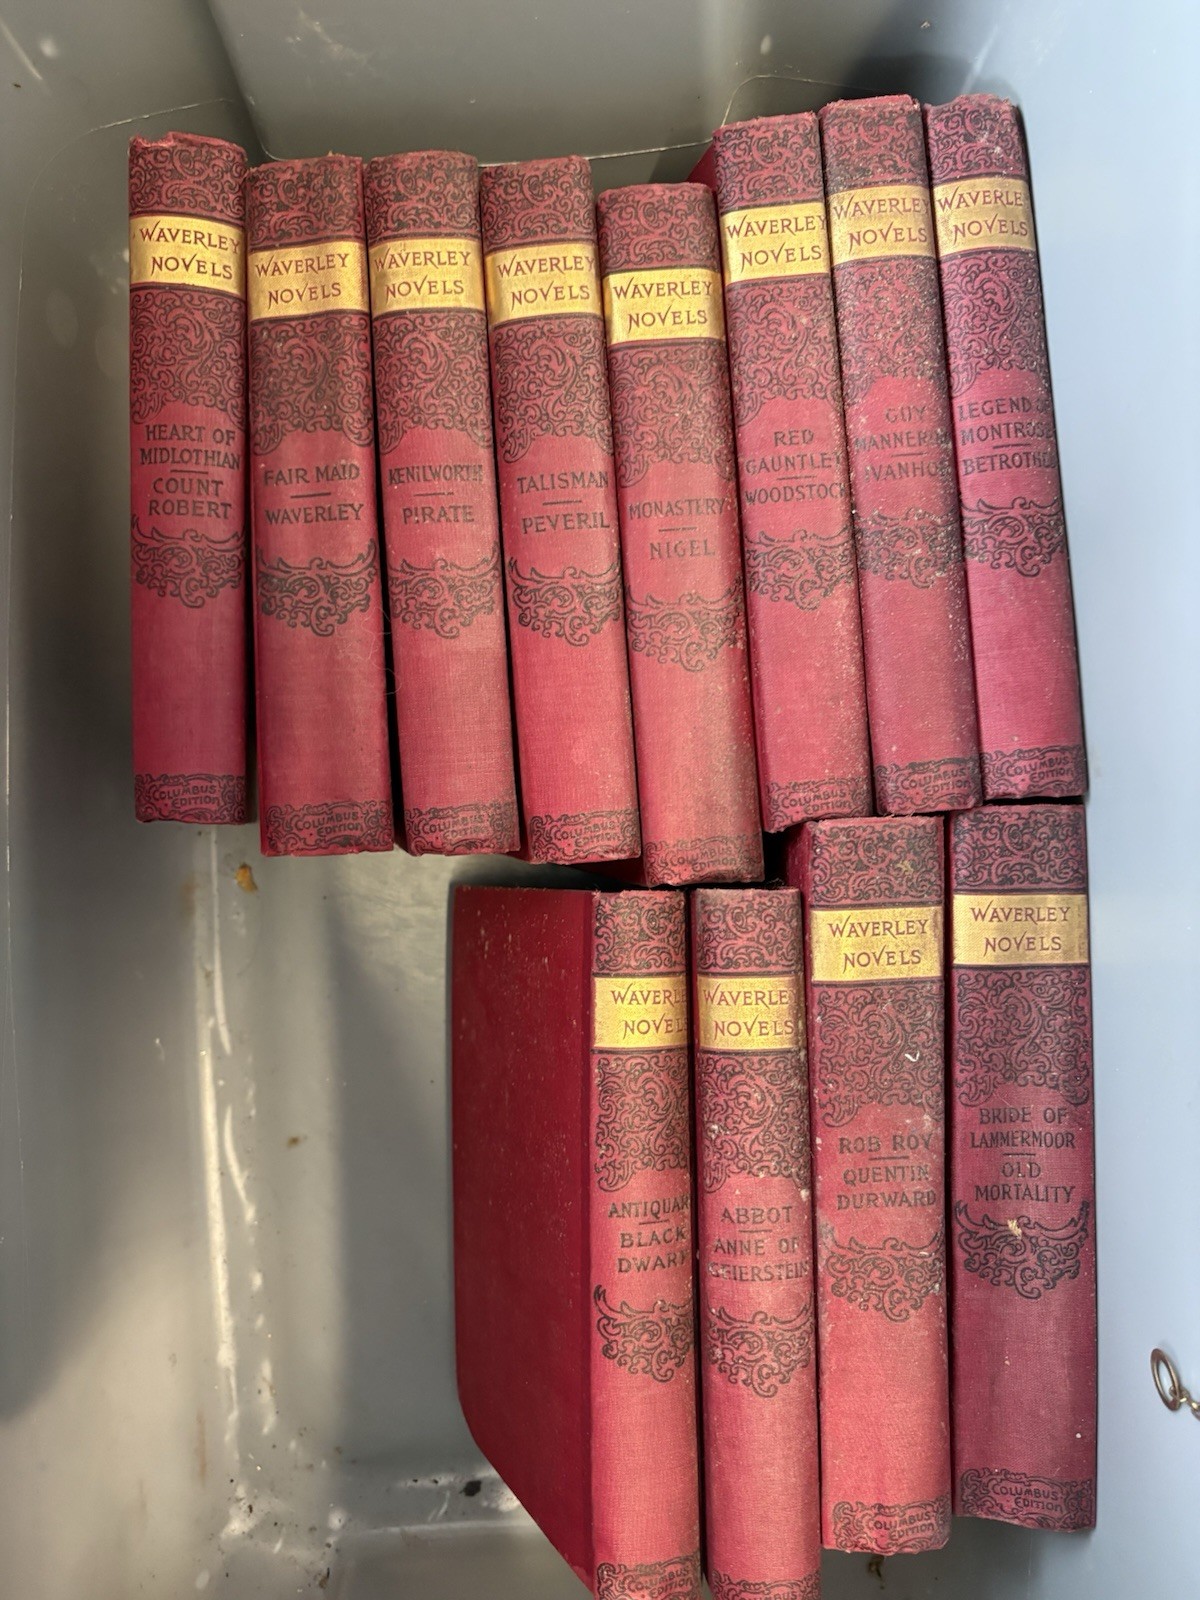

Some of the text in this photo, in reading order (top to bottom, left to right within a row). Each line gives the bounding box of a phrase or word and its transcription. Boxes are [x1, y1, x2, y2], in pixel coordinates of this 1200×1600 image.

[833, 195, 930, 220] WAVERLEY
[139, 221, 241, 253] WAVERLEY
[726, 215, 827, 239] WAVERLEY
[849, 221, 928, 253] NOVELS
[953, 213, 1028, 245] NOVELS
[151, 254, 233, 280] NOVELS
[256, 253, 350, 279] WAVERLEY
[375, 249, 471, 272] WAVERLEY
[497, 254, 595, 278] WAVERLEY
[740, 242, 822, 273] NOVELS
[268, 282, 342, 309] NOVELS
[384, 275, 465, 303] NOVELS
[511, 282, 590, 310] NOVELS
[614, 277, 712, 301] WAVERLEY
[627, 305, 708, 333] NOVELS
[886, 405, 926, 423] GUY
[957, 397, 1032, 422] LEGEND
[146, 425, 236, 447] HEART OF
[774, 429, 814, 447] RED
[140, 448, 241, 470] MIDLOTHIAN
[745, 452, 841, 475] GAUNTLET
[263, 464, 360, 486] FAIR MAID
[388, 464, 483, 484] KENILWORTH
[864, 460, 948, 482] IVANHO
[153, 477, 224, 496] COUNT
[517, 471, 609, 494] TALISMAN
[744, 482, 846, 505] WOODSTOCK
[149, 500, 232, 519] ROBERT
[265, 503, 364, 525] WAVERLEY
[402, 505, 475, 525] PIRATE
[628, 498, 725, 520] MONASTERY
[522, 512, 610, 534] PEVERIL
[650, 539, 716, 560] NIGEL
[153, 785, 217, 801] COLUMBUS
[295, 812, 359, 830] COLUMBUS
[970, 900, 1071, 924] WAVERLEY
[828, 915, 929, 940] WAVERLEY
[983, 931, 1062, 957] NOVELS
[842, 945, 921, 973] NOVELS
[713, 1014, 794, 1040] NOVELS
[979, 1107, 1068, 1125] BRIDE OF
[838, 1133, 934, 1155] ROB ROY
[970, 1130, 1076, 1149] LAMMERMOOR
[842, 1165, 929, 1187] QUENTIN
[1002, 1162, 1042, 1179] OLD
[837, 1190, 936, 1211] DURWARD
[974, 1185, 1076, 1203] MORTALITY
[720, 1206, 793, 1224] ABBOT
[620, 1227, 686, 1248] BLACK
[714, 1236, 800, 1256] ANNE OF
[707, 1260, 809, 1282] GEIERSTEIN
[992, 1485, 1058, 1500] COLUMBUS
